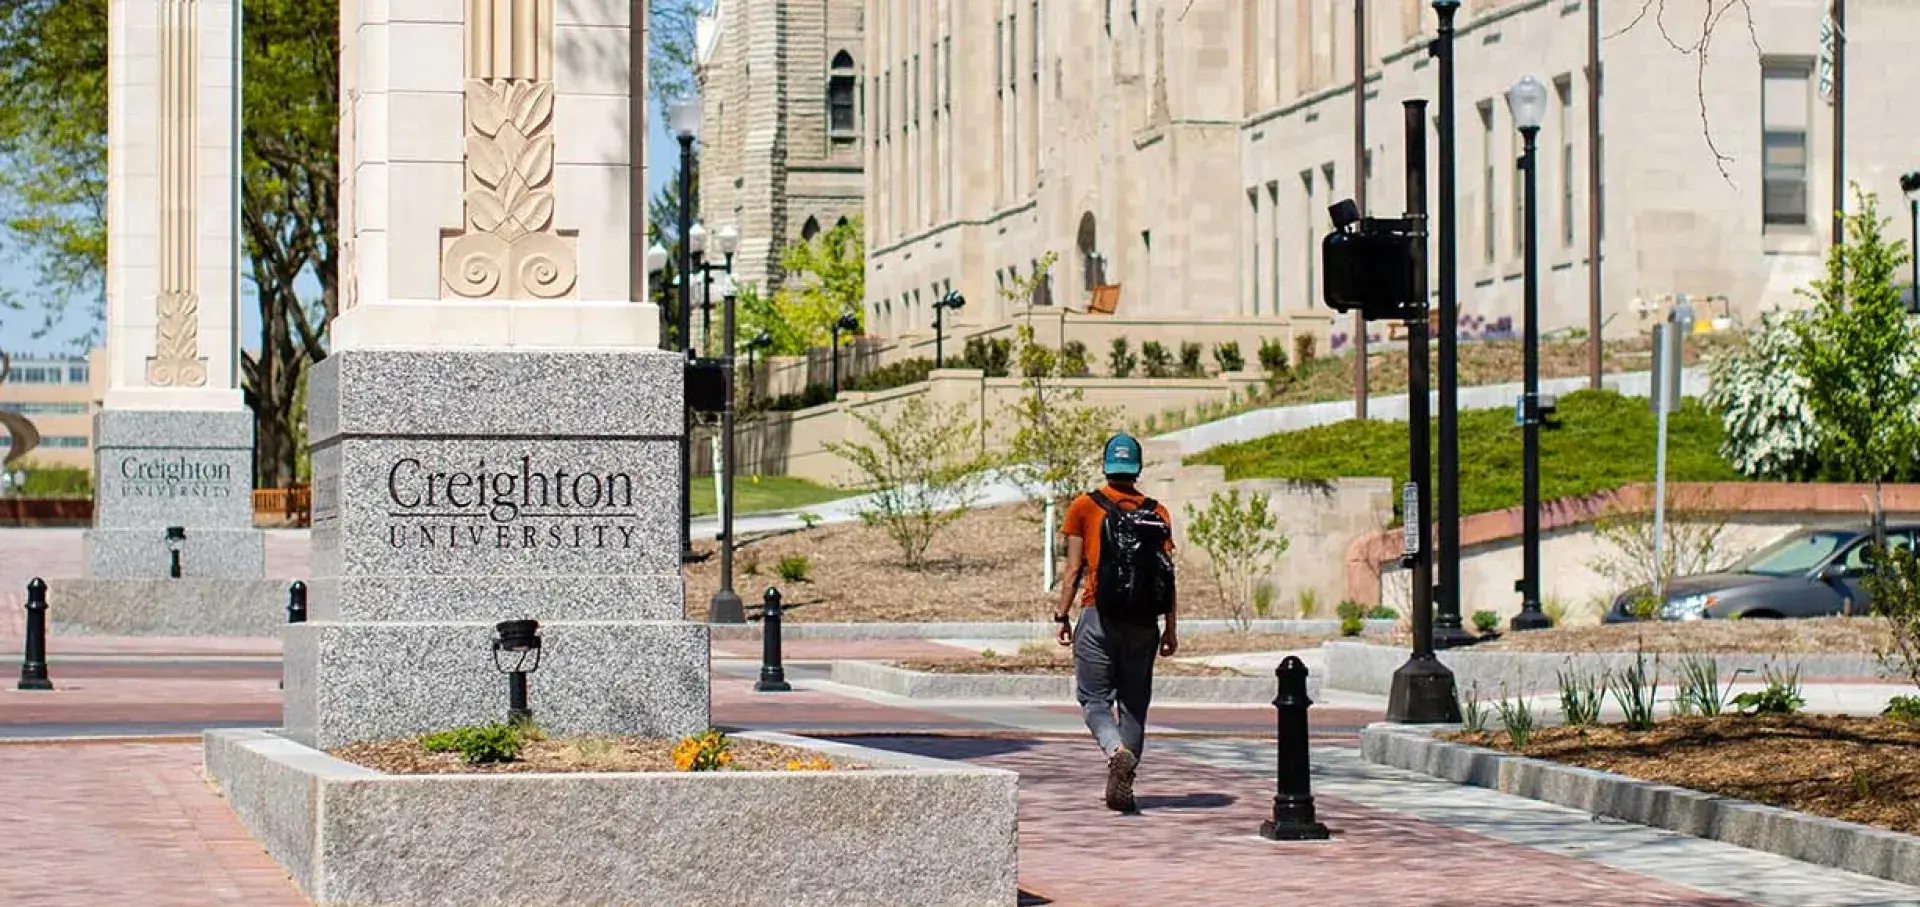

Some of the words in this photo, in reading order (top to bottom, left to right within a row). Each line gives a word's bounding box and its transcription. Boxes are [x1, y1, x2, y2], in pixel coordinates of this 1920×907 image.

[121, 456, 231, 485] Creighton
[121, 486, 231, 498] UNIVERSITY
[387, 455, 633, 523] Creighton
[389, 525, 636, 549] UNIVERSITY
